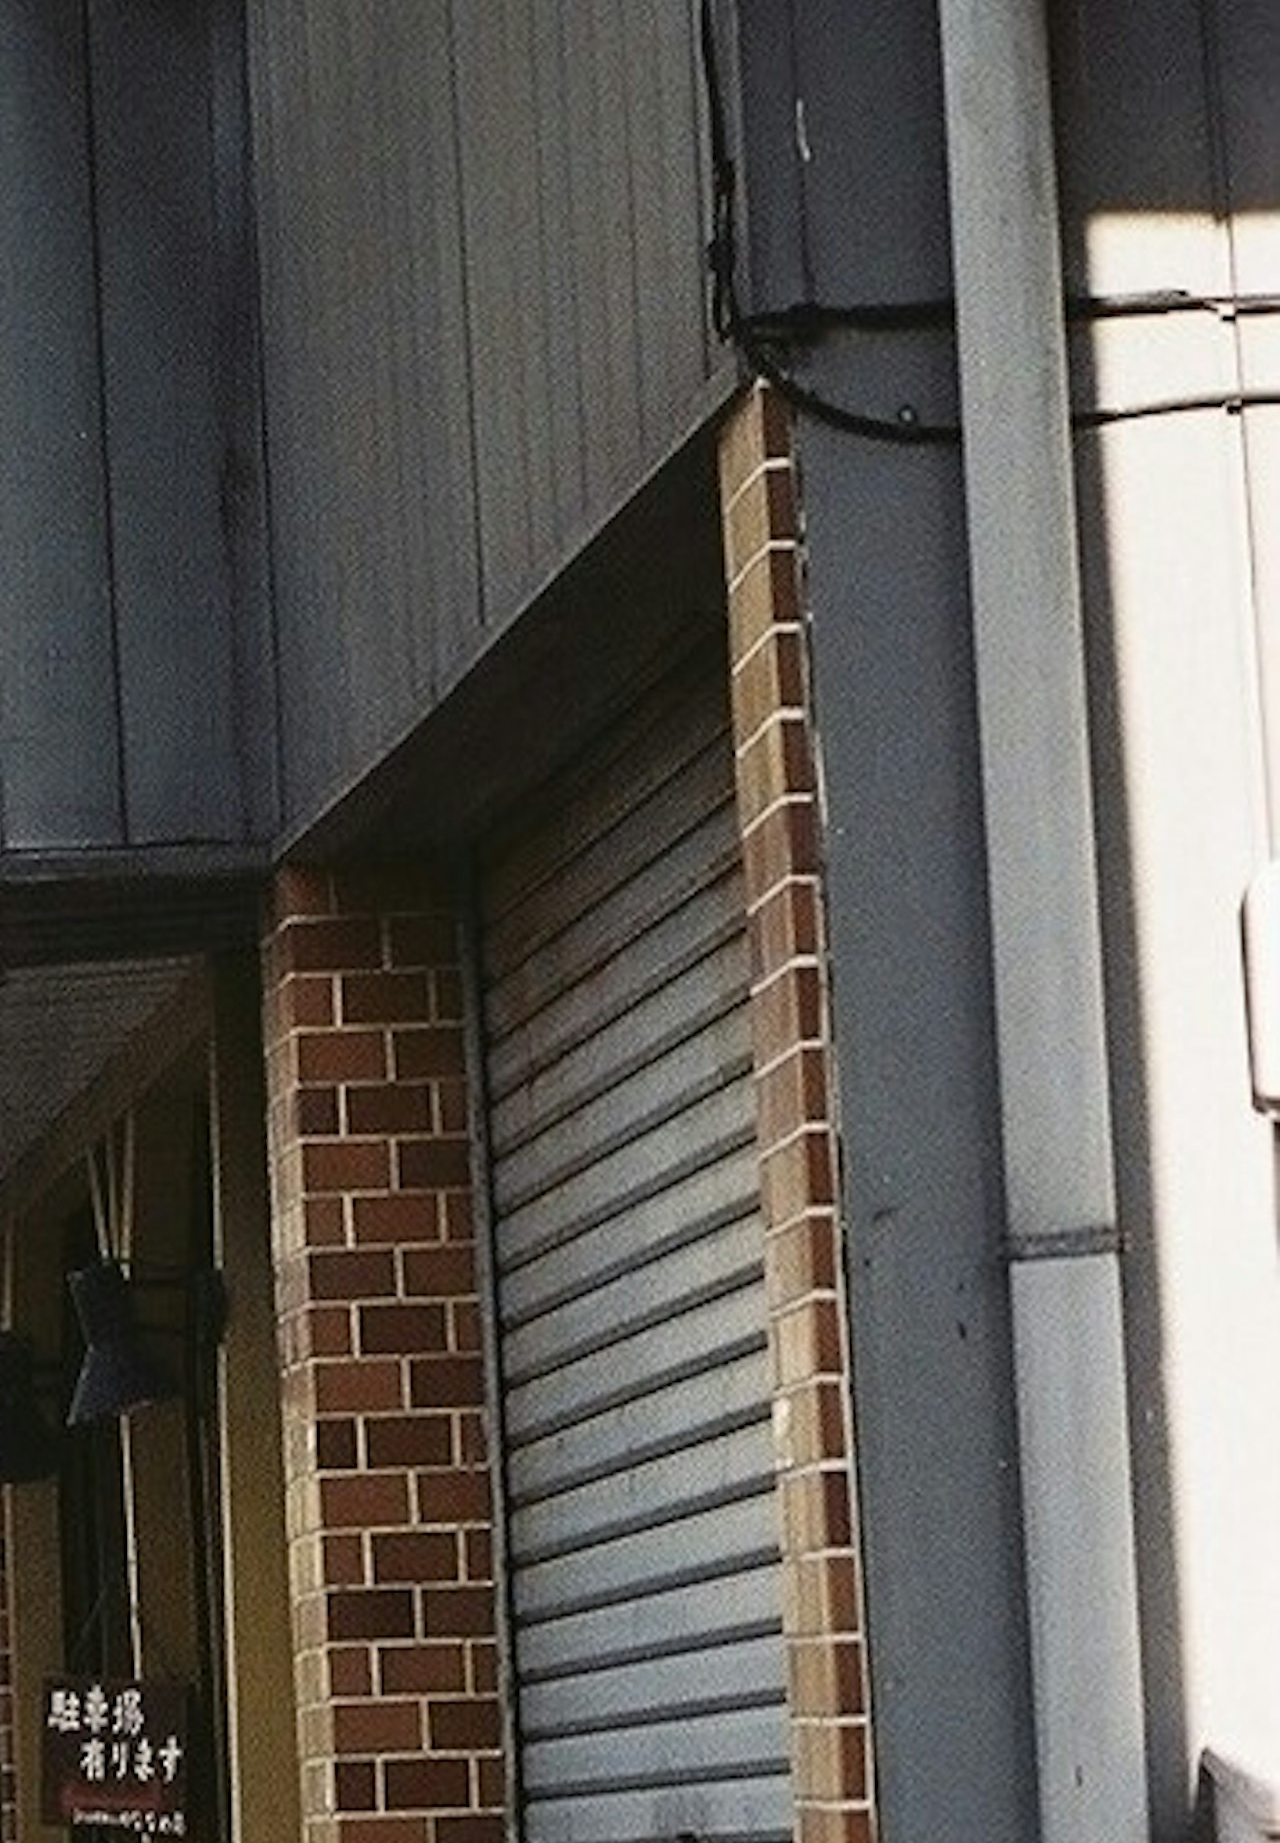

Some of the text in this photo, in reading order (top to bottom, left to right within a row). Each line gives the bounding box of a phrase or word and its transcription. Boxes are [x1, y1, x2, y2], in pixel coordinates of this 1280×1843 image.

[46, 1683, 146, 1737] 駐車場
[79, 1735, 184, 1783] 有ります
